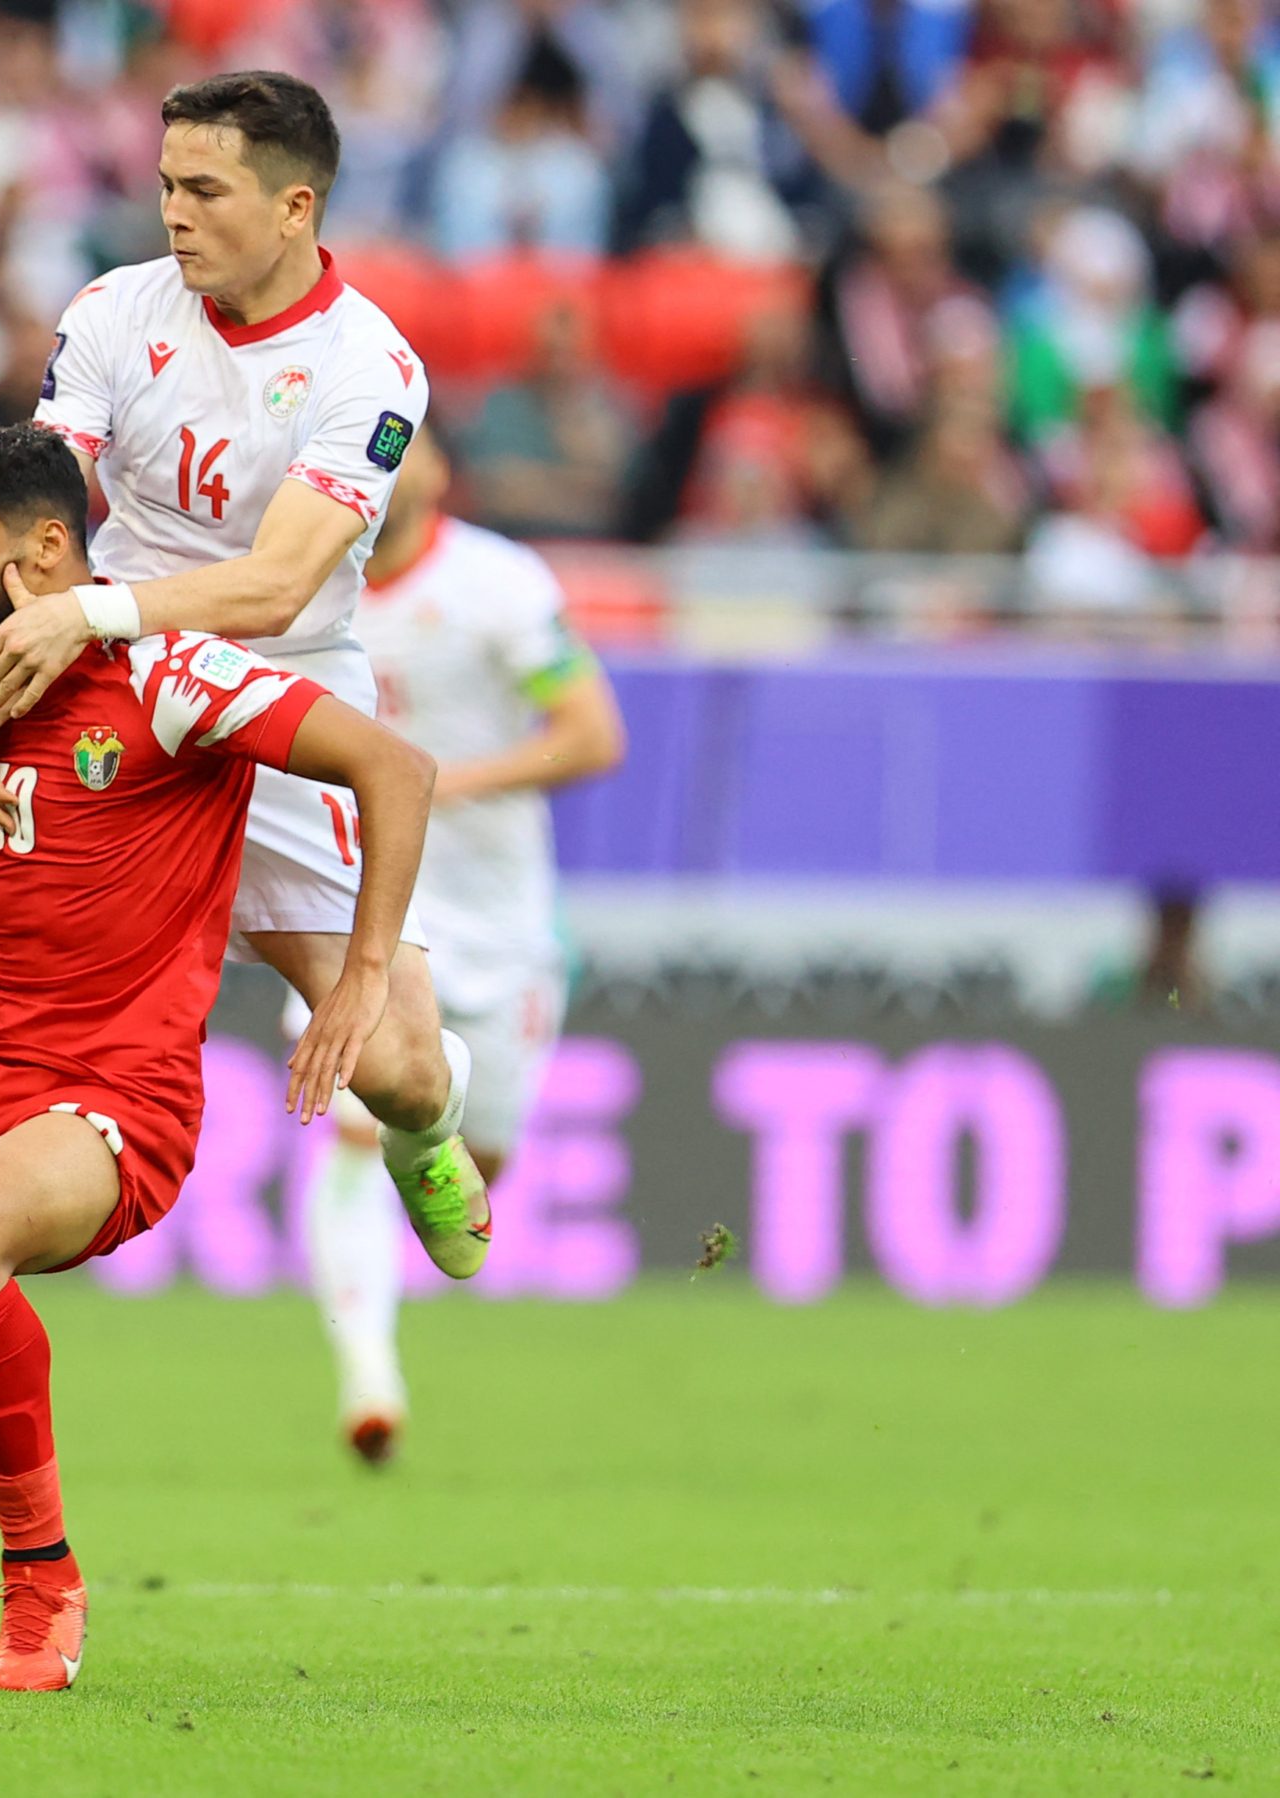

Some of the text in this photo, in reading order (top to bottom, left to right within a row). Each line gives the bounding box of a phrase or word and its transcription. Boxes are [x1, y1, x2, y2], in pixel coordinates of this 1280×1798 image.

[378, 425, 408, 450] LIVE
[385, 416, 404, 433] AFC
[178, 424, 230, 521] 14
[200, 652, 216, 671] AFC
[208, 649, 236, 677] LIVE
[320, 791, 362, 866] 1
[712, 1040, 1067, 1307] TO
